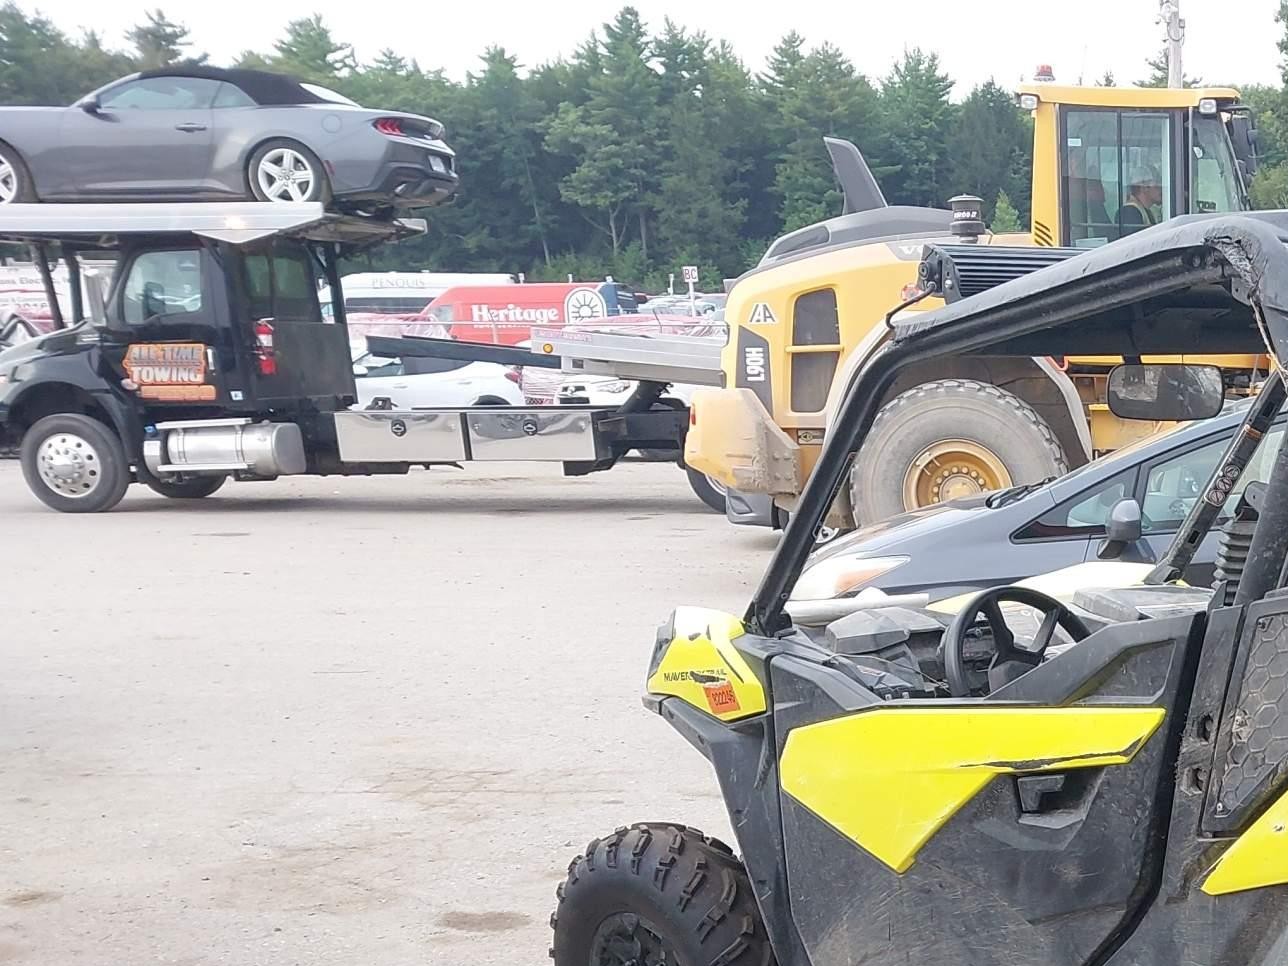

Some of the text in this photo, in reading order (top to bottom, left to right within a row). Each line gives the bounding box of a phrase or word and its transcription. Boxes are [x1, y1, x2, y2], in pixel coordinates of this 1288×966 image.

[684, 268, 697, 280] BC
[471, 303, 559, 323] Heritage
[161, 344, 200, 361] TIME
[744, 347, 765, 382] L90H
[132, 366, 201, 382] TOWING
